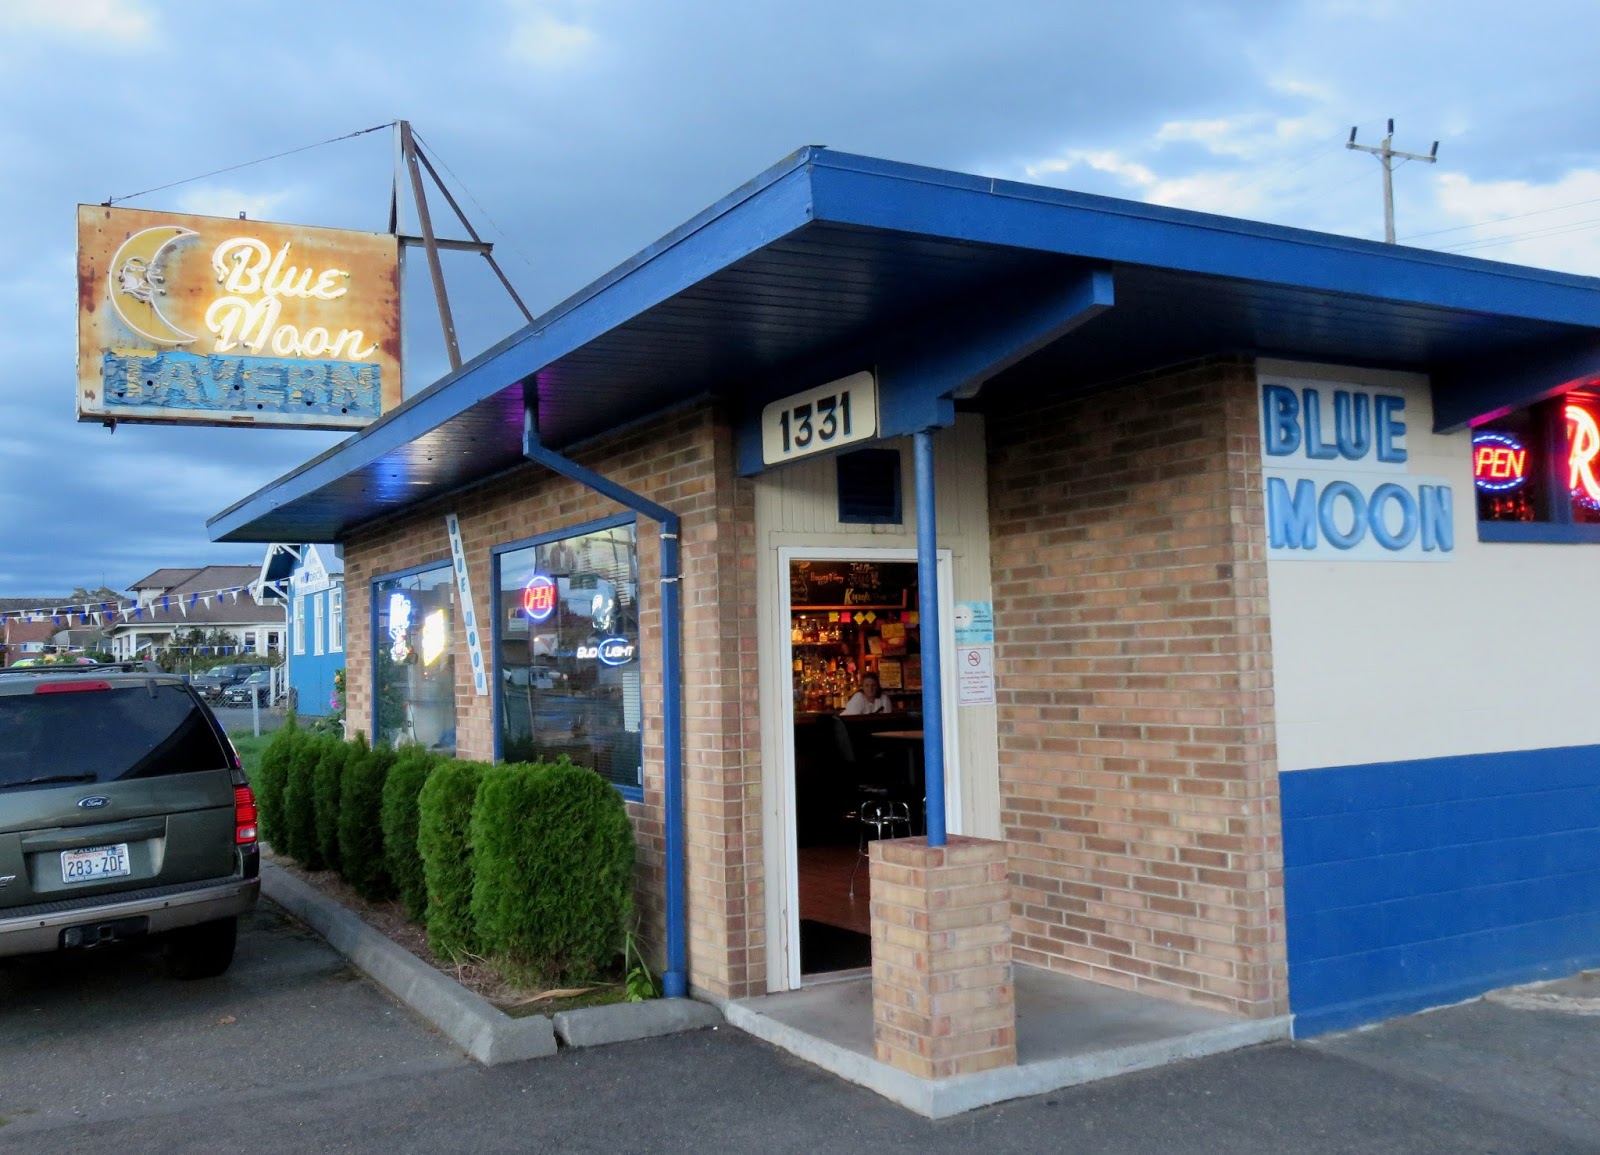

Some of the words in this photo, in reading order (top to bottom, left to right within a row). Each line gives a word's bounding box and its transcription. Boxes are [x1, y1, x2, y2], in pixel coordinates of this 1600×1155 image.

[212, 237, 350, 300] Blue
[205, 295, 379, 361] Moon
[779, 391, 851, 453] 1331
[1263, 384, 1408, 464] BLUE
[1475, 448, 1526, 478] PEN
[1267, 476, 1455, 552] MOON
[524, 585, 556, 610] OPEN
[576, 646, 598, 659] BUD
[604, 646, 635, 658] LIGHT
